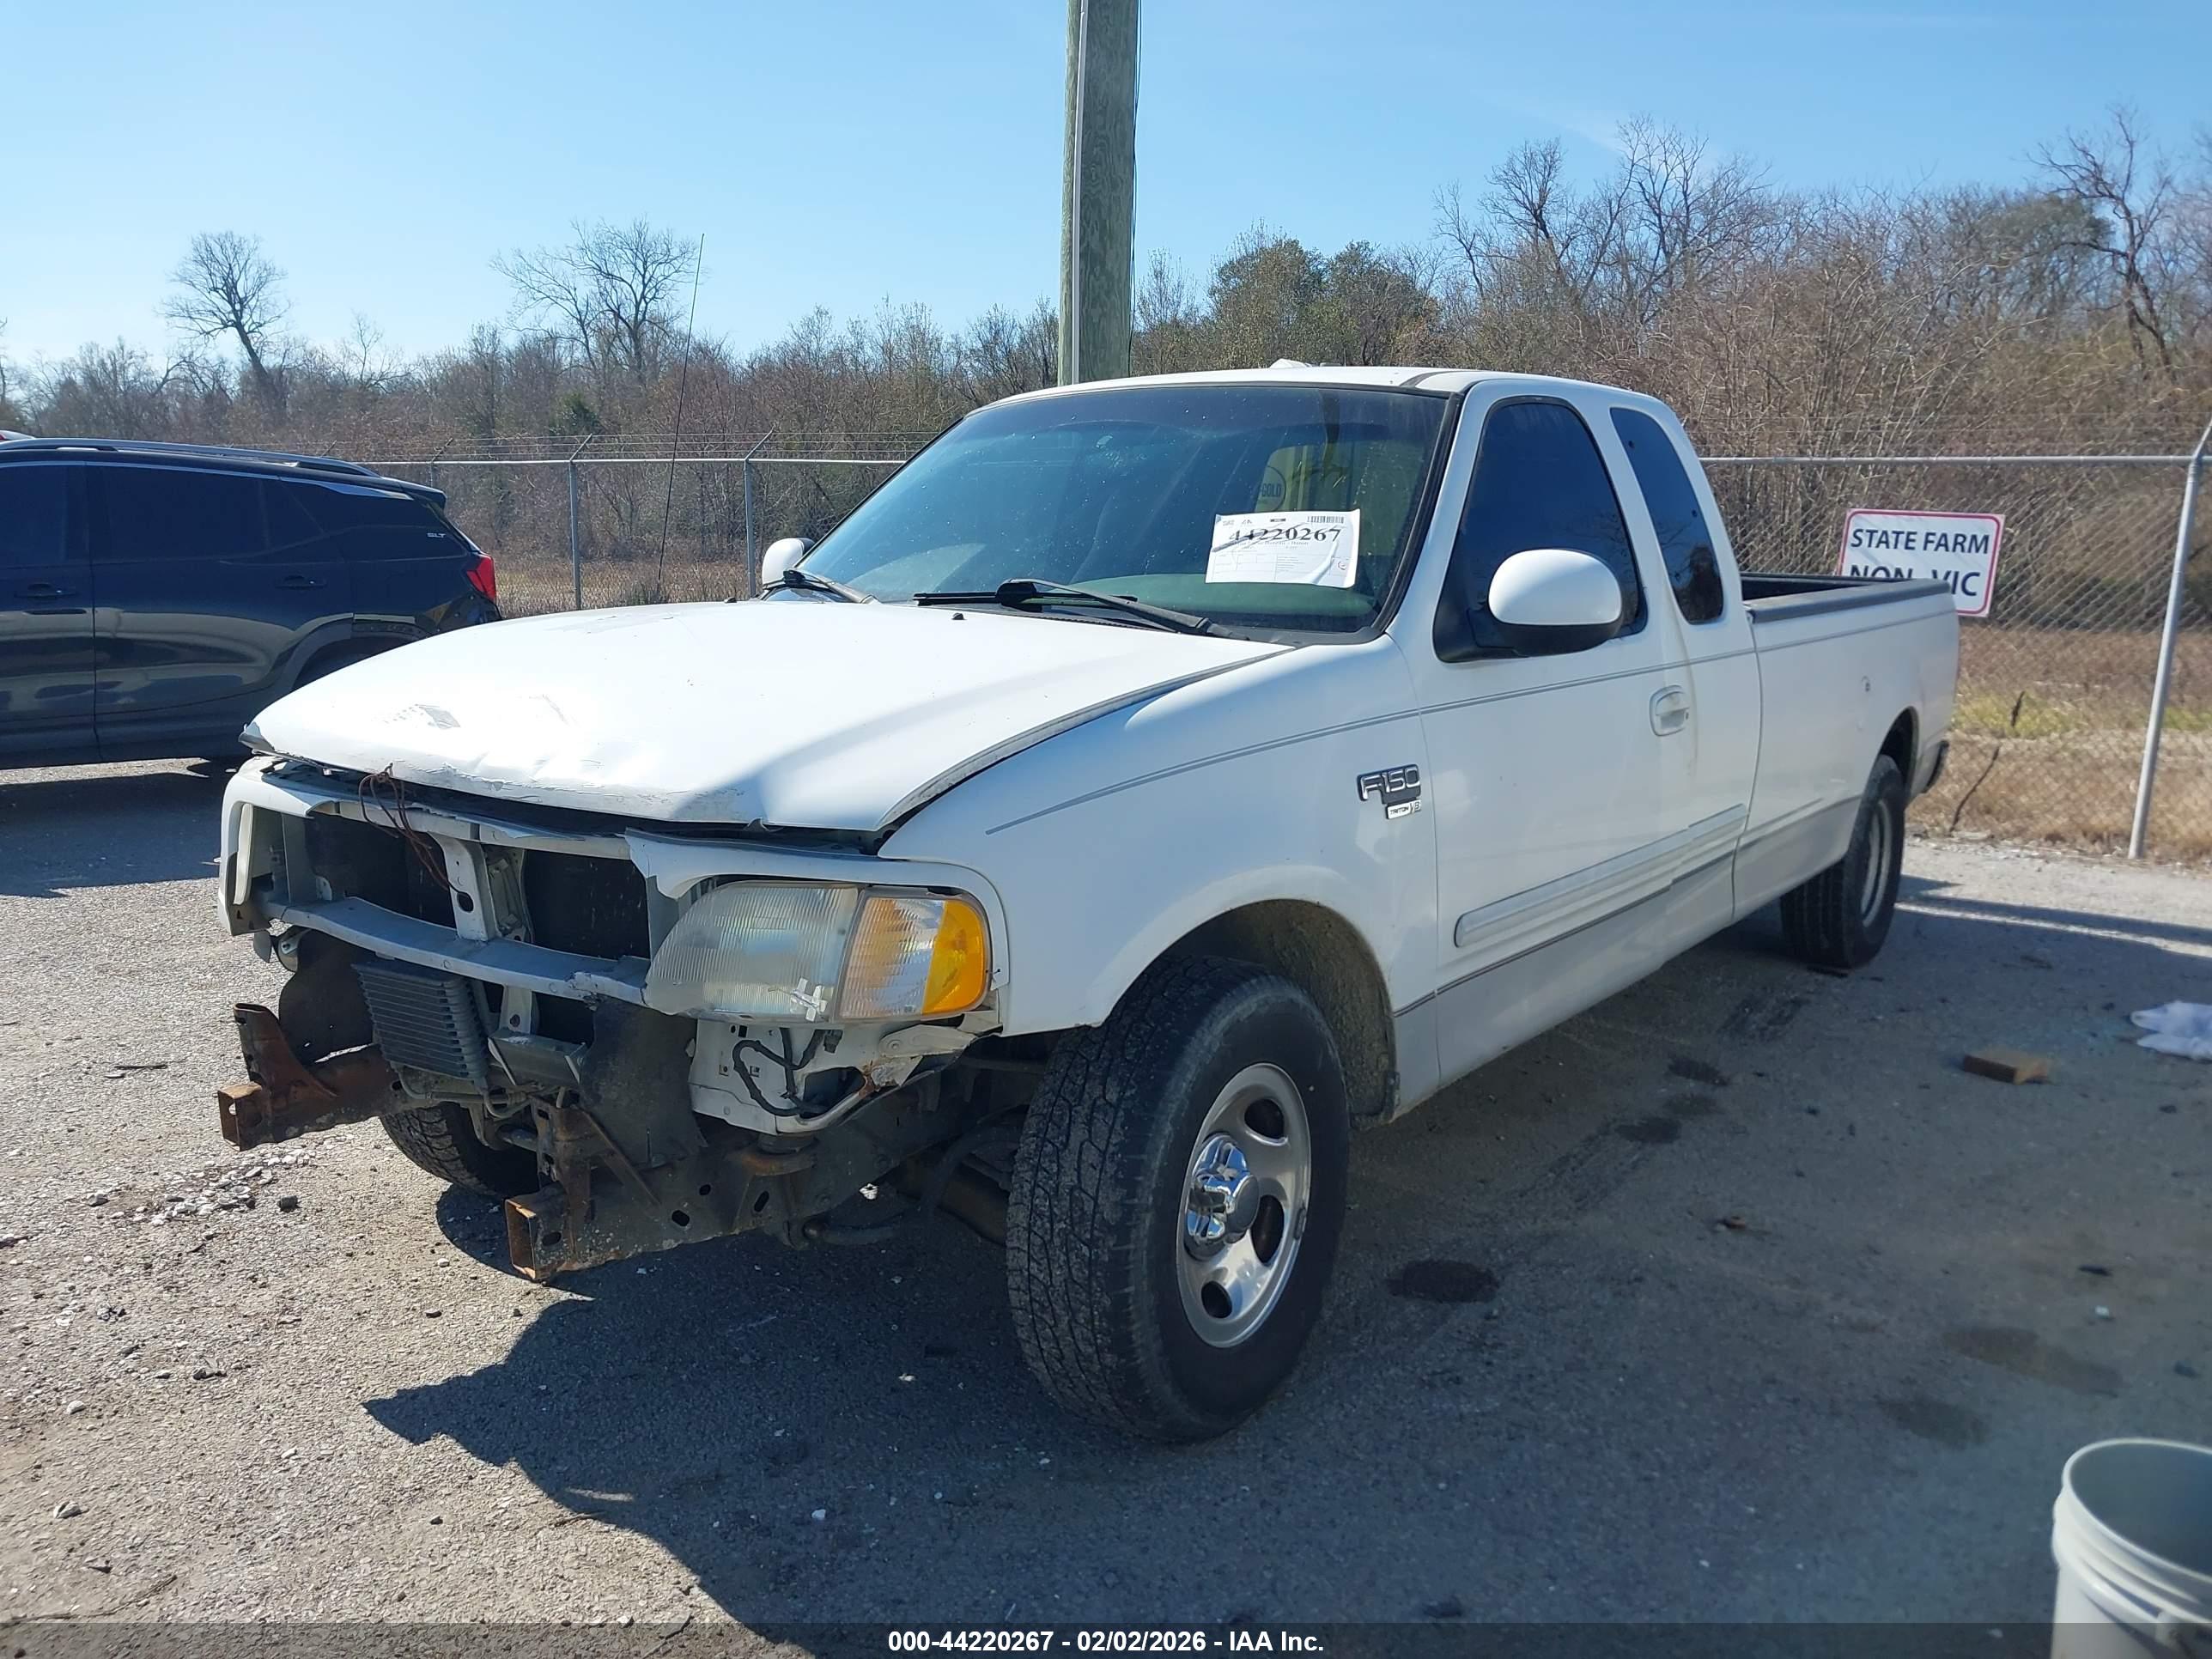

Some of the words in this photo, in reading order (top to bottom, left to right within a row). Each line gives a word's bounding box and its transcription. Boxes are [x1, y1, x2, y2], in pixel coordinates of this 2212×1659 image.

[1229, 527, 1340, 542] 44220267
[1850, 528, 1917, 550] STATE
[1923, 532, 1990, 555] FARM
[1931, 569, 1980, 596] VIC
[1389, 806, 1410, 815] TRITON
[1409, 801, 1420, 815] V8
